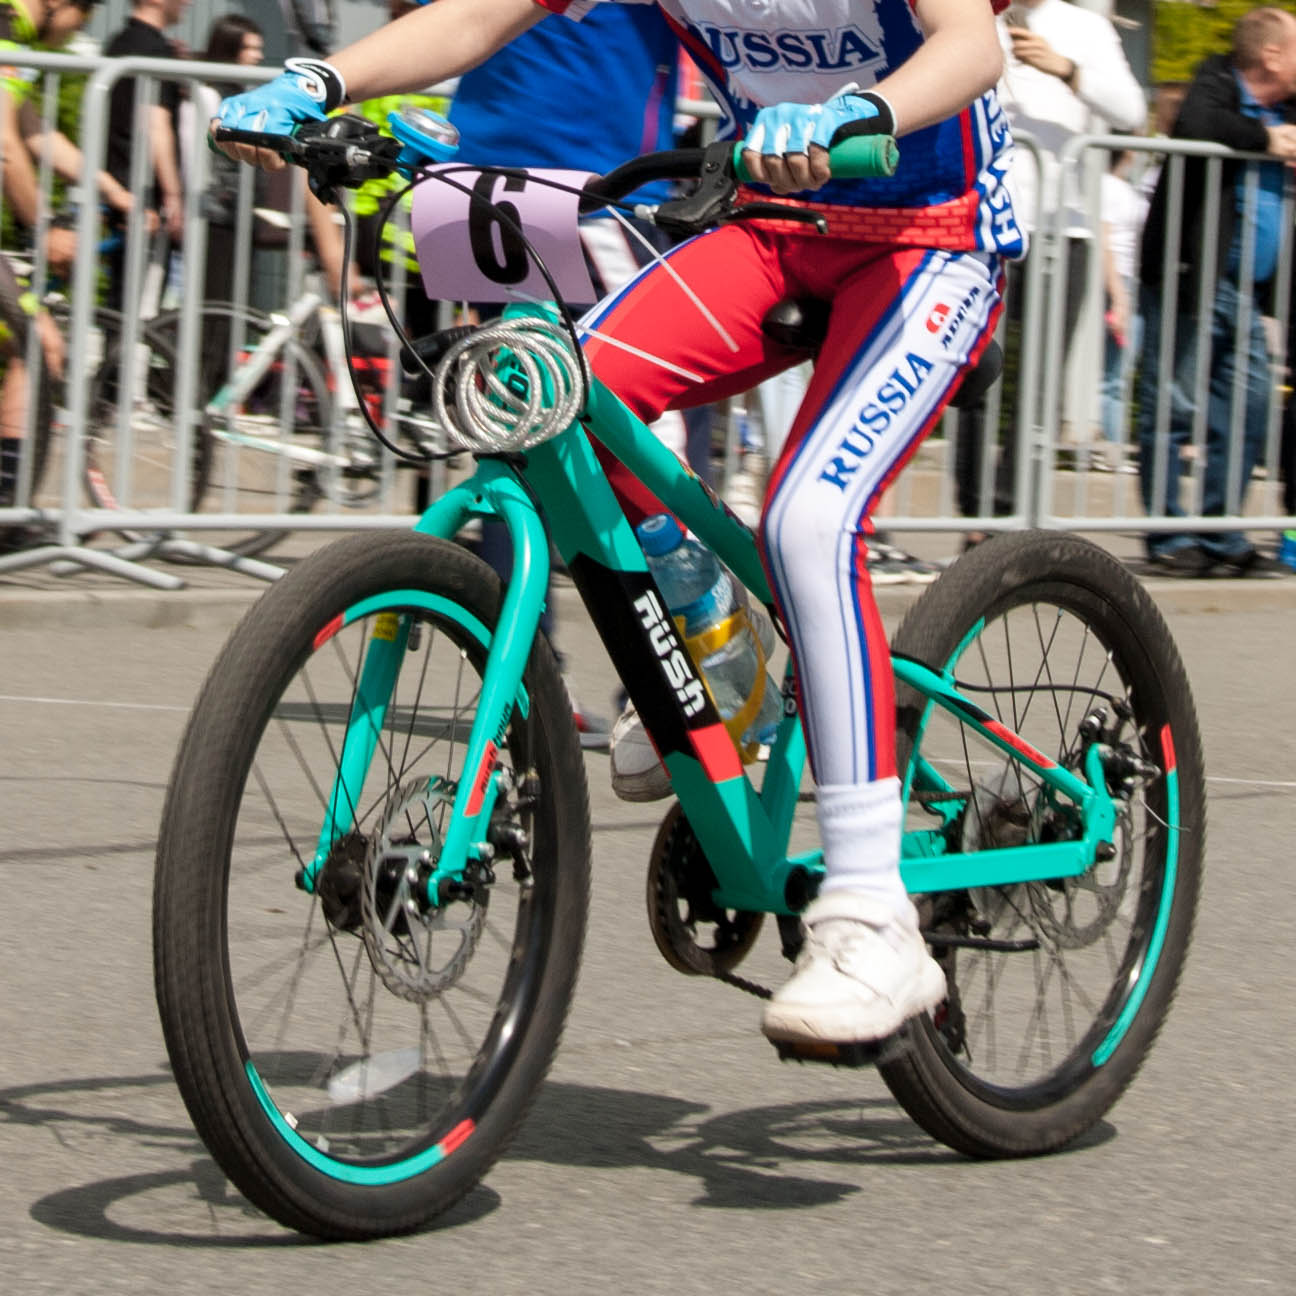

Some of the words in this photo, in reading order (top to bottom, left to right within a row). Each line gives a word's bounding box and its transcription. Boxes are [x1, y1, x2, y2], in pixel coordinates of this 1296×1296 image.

[689, 26, 881, 69] USSIA
[469, 168, 529, 285] 6
[819, 352, 934, 492] RUSSIA
